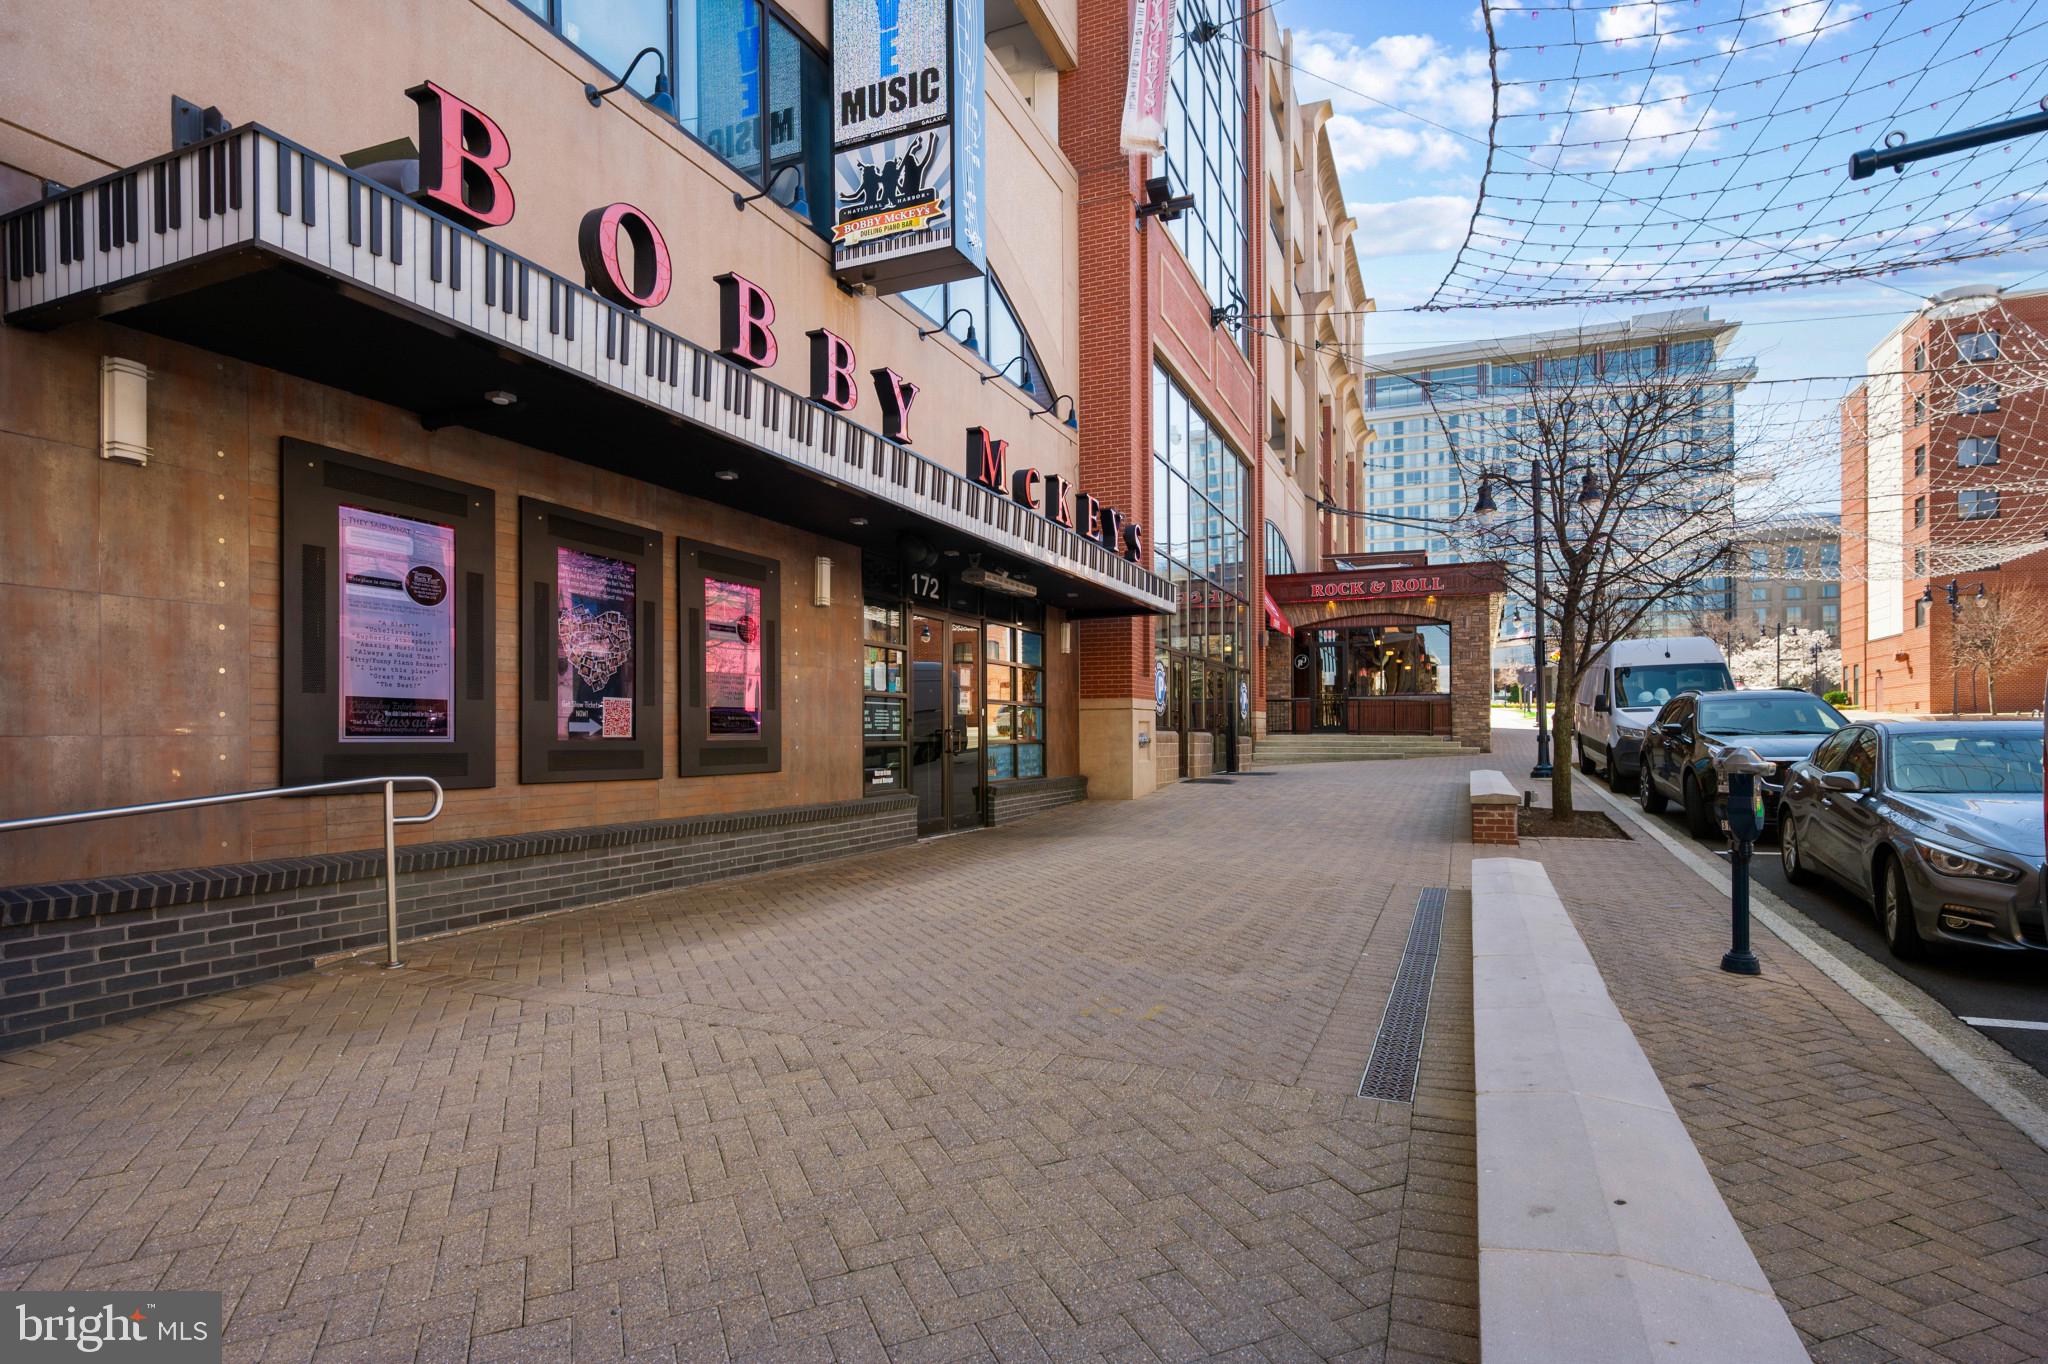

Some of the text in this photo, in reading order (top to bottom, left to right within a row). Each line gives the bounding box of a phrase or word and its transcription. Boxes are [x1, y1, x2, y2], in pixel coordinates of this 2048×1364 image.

[841, 67, 940, 126] MUSIC
[847, 193, 926, 215] NATIONAL HARBOR
[844, 217, 881, 234] BOBBY
[860, 220, 913, 238] DUELING PIANO BAR
[404, 79, 920, 446] BOBBY
[911, 573, 940, 600] 172
[1311, 576, 1445, 598] ROCK & ROLL
